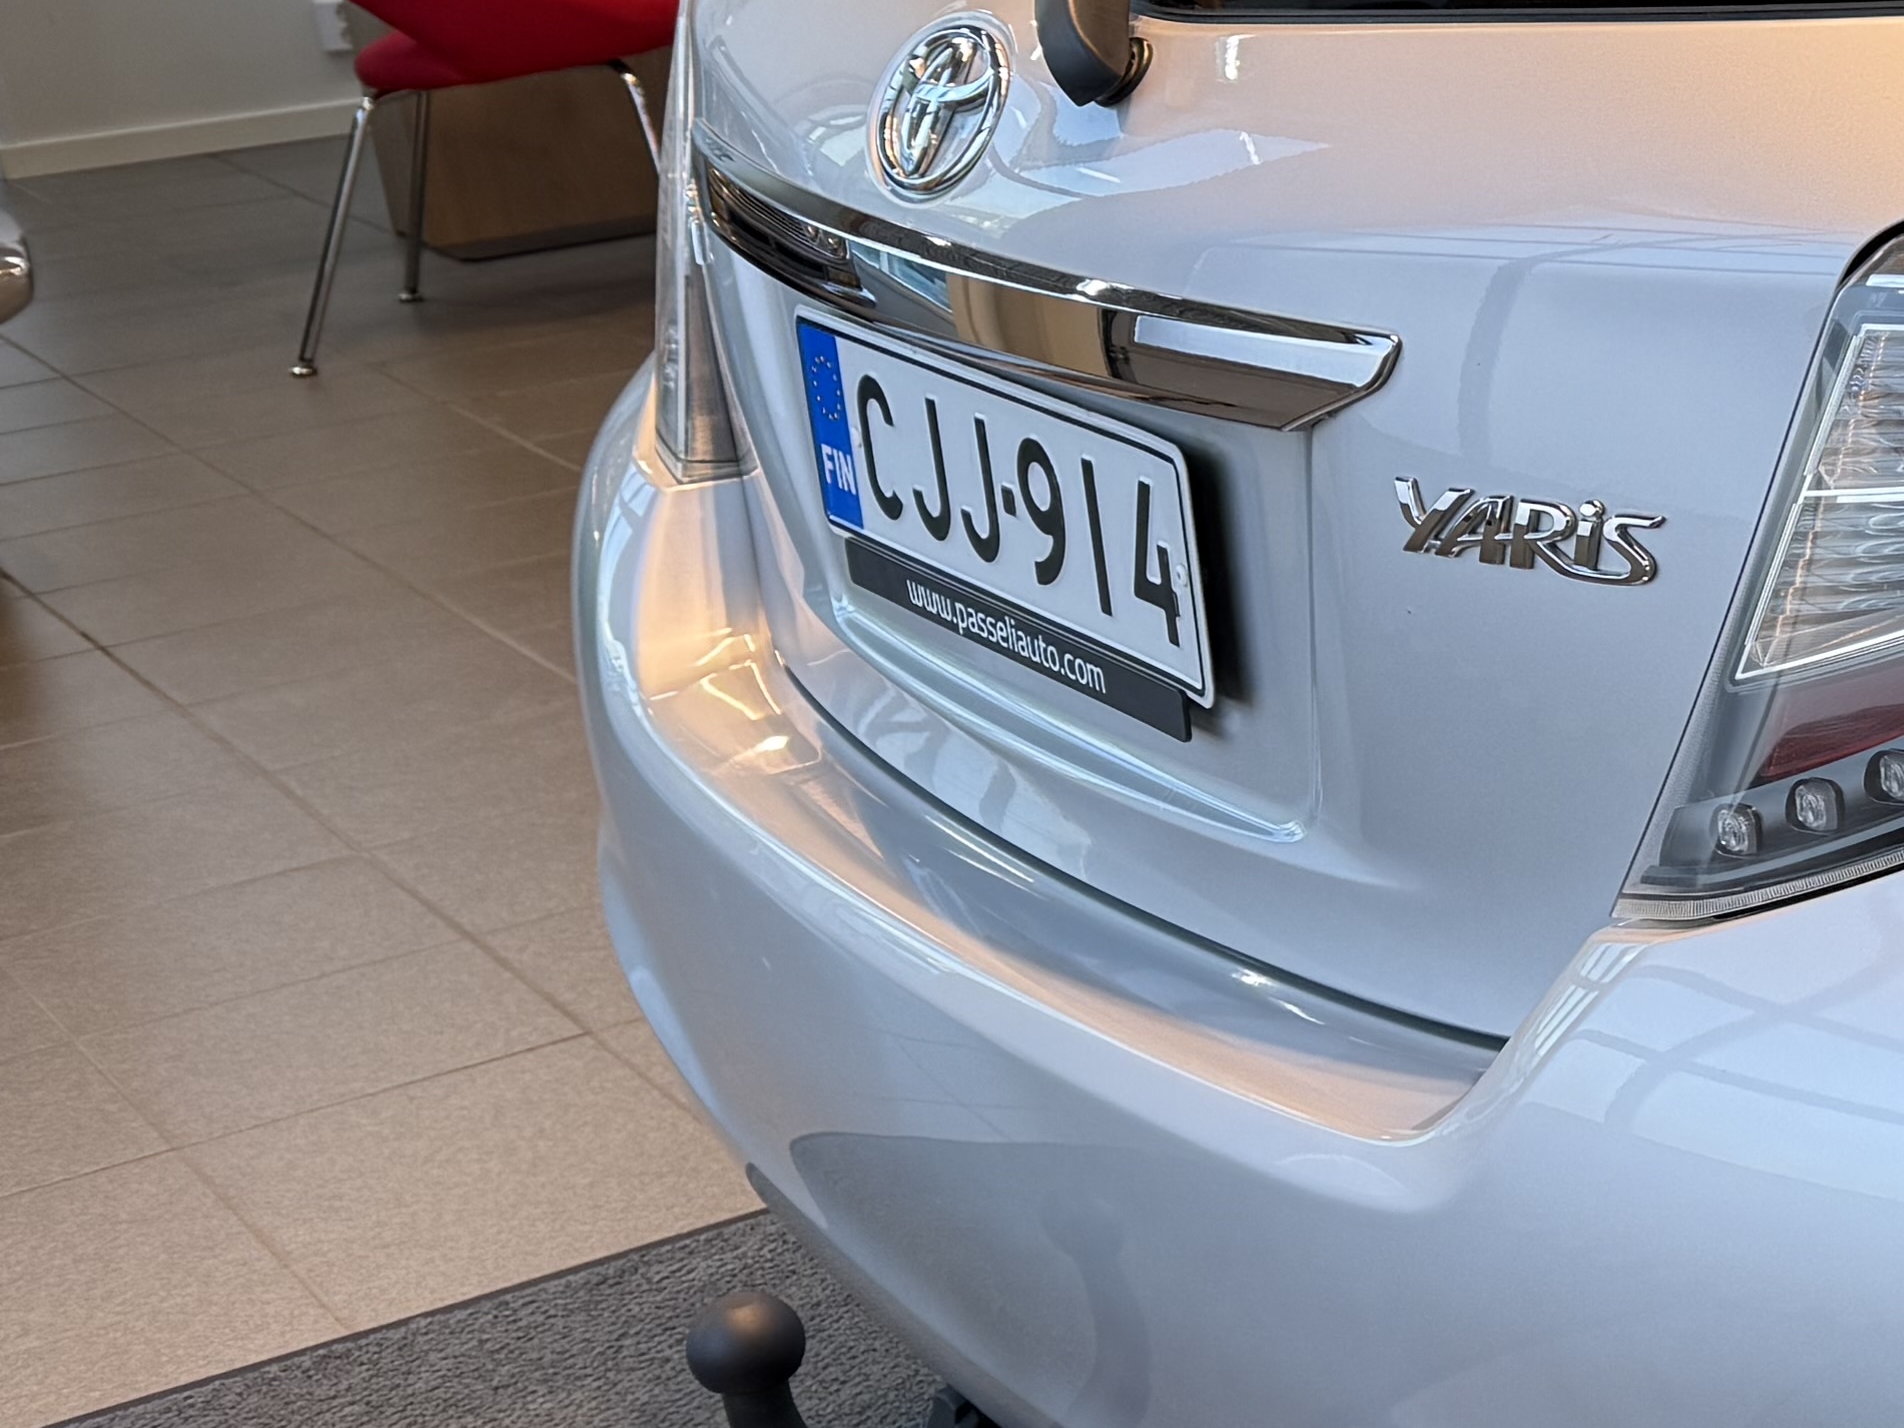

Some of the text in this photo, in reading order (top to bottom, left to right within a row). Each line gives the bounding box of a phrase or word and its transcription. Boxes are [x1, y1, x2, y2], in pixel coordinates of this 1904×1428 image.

[819, 442, 857, 496] FIN
[856, 373, 1180, 648] CJJ-914
[907, 576, 1107, 695] www.passeliauto.com
